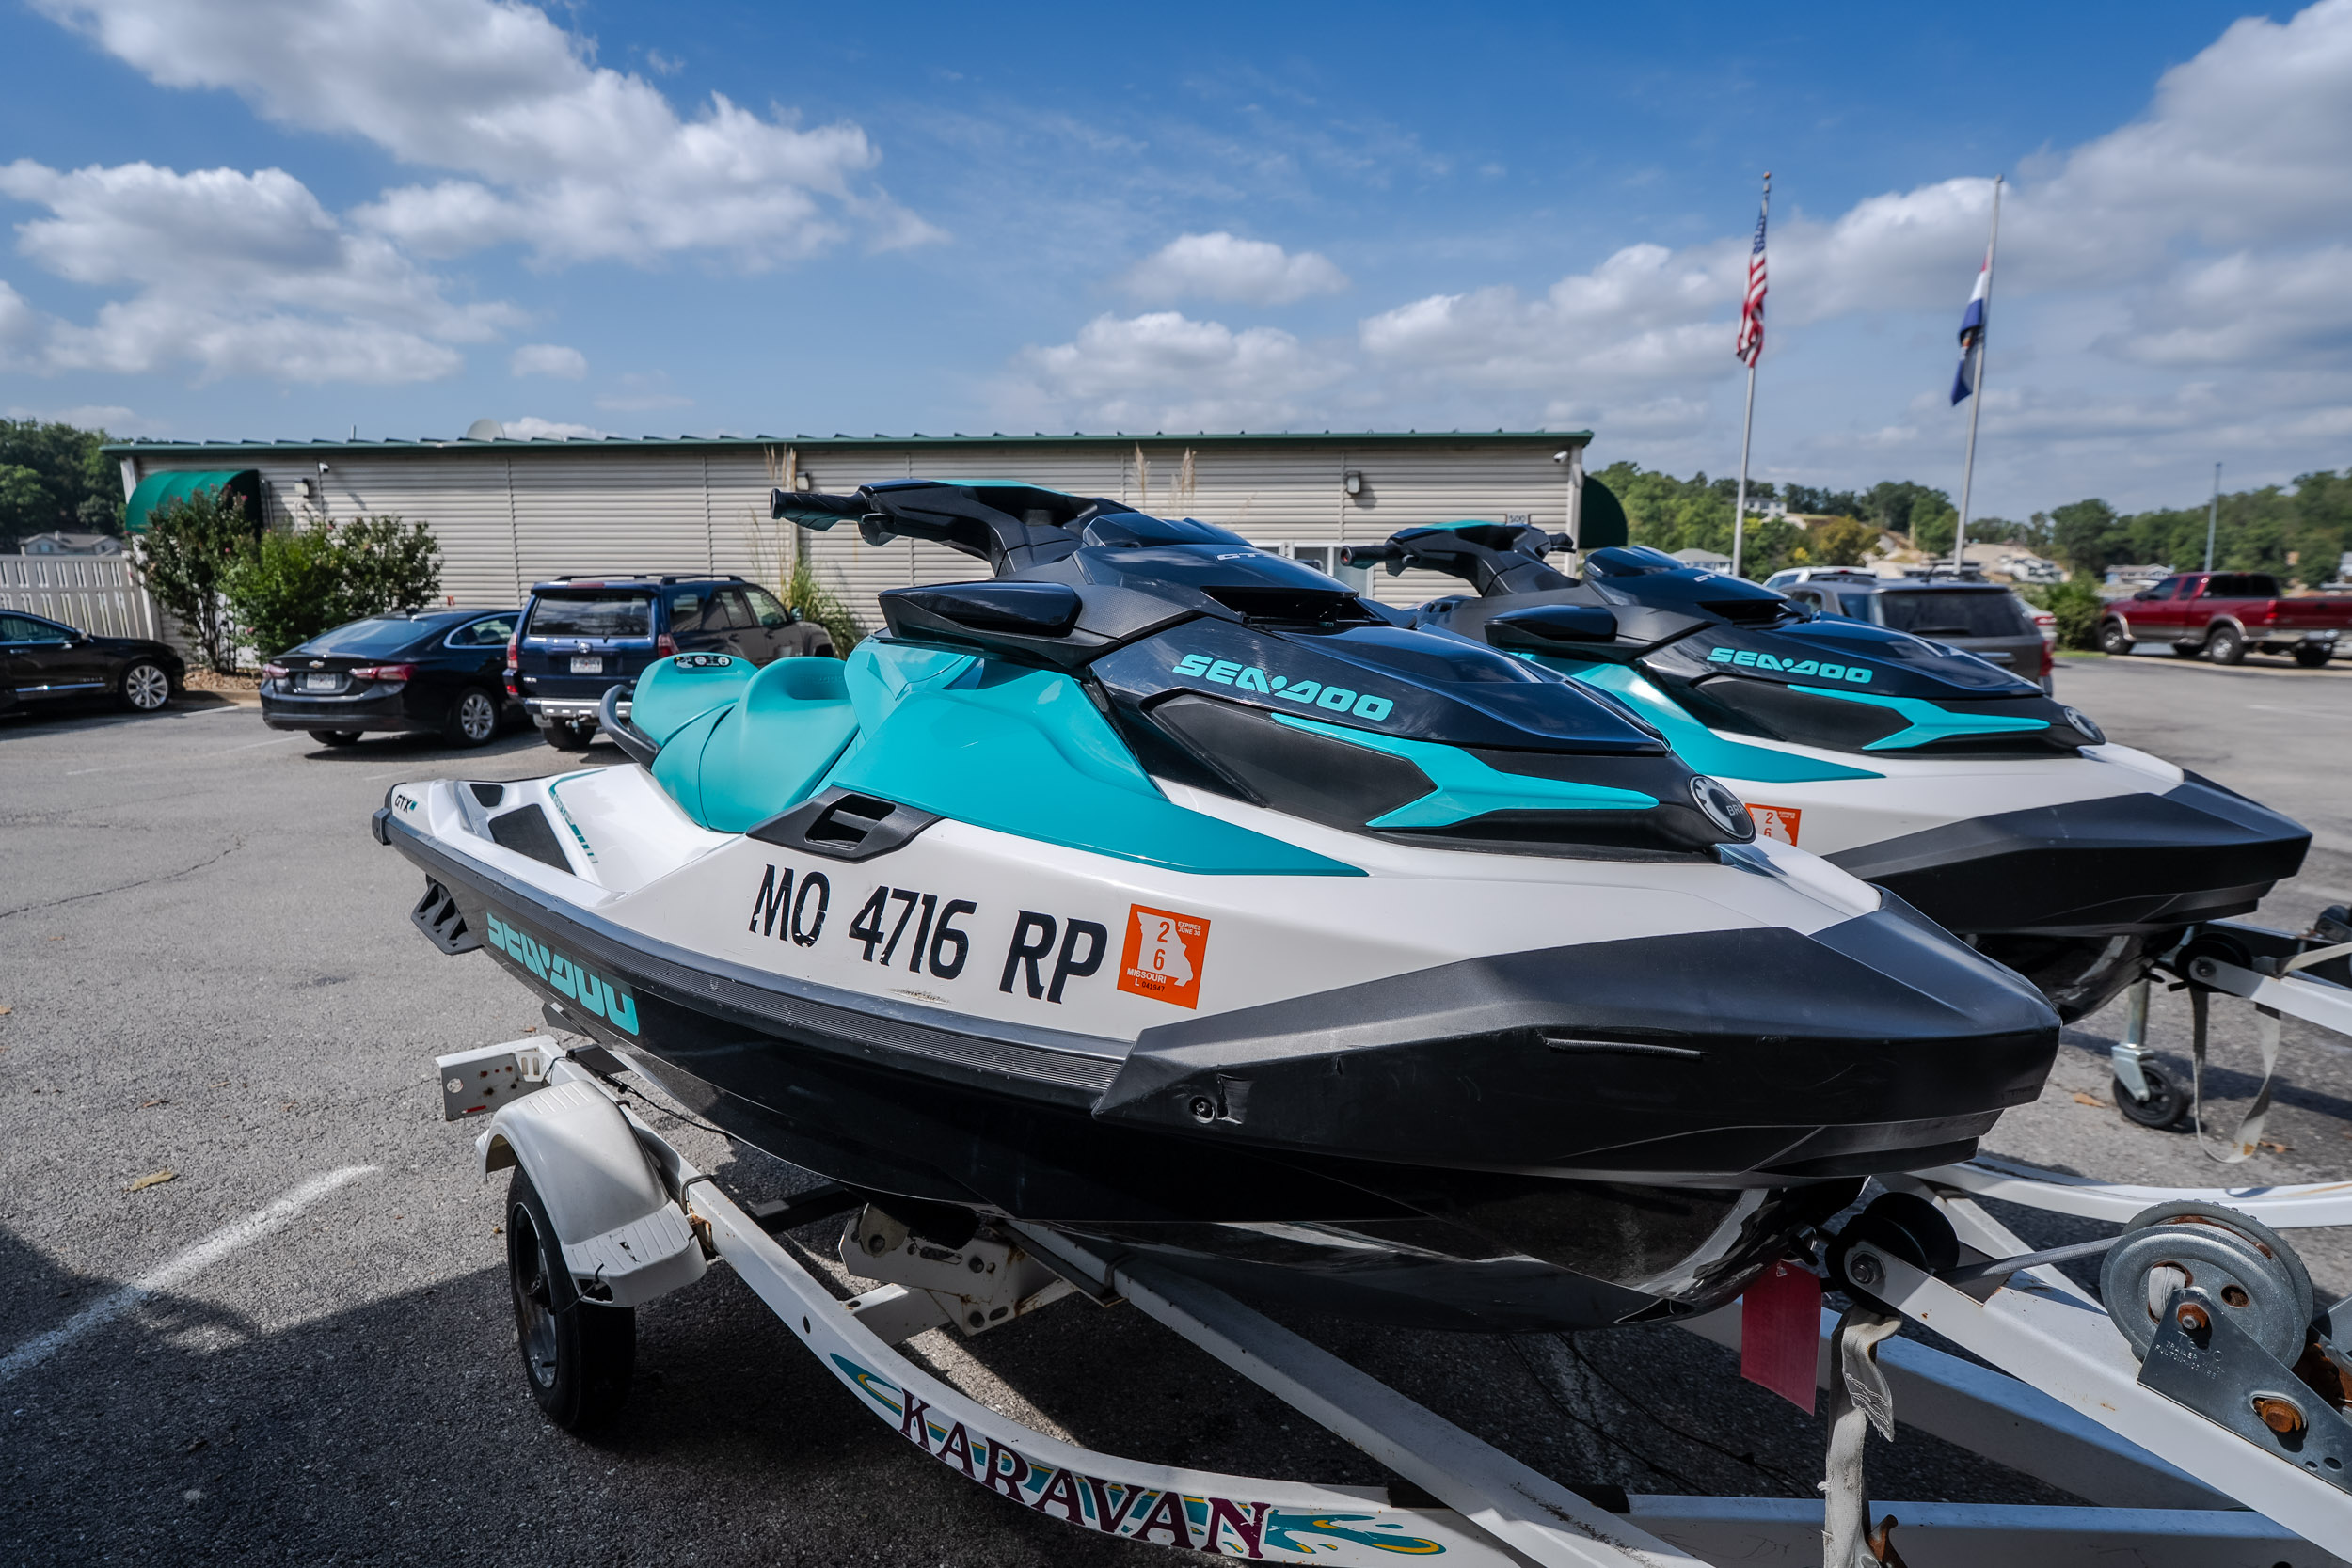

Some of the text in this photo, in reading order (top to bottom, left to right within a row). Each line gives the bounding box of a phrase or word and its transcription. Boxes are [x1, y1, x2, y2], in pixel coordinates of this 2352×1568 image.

[395, 794, 412, 813] GTX
[1765, 812, 1774, 824] 2
[749, 863, 1108, 1005] MO 4716 RP
[1157, 921, 1170, 943] 2
[1178, 921, 1201, 931] EXPIRES
[1153, 948, 1166, 971] 6
[1127, 967, 1167, 984] MISSOURI
[900, 1388, 1271, 1559] KARAVAN
